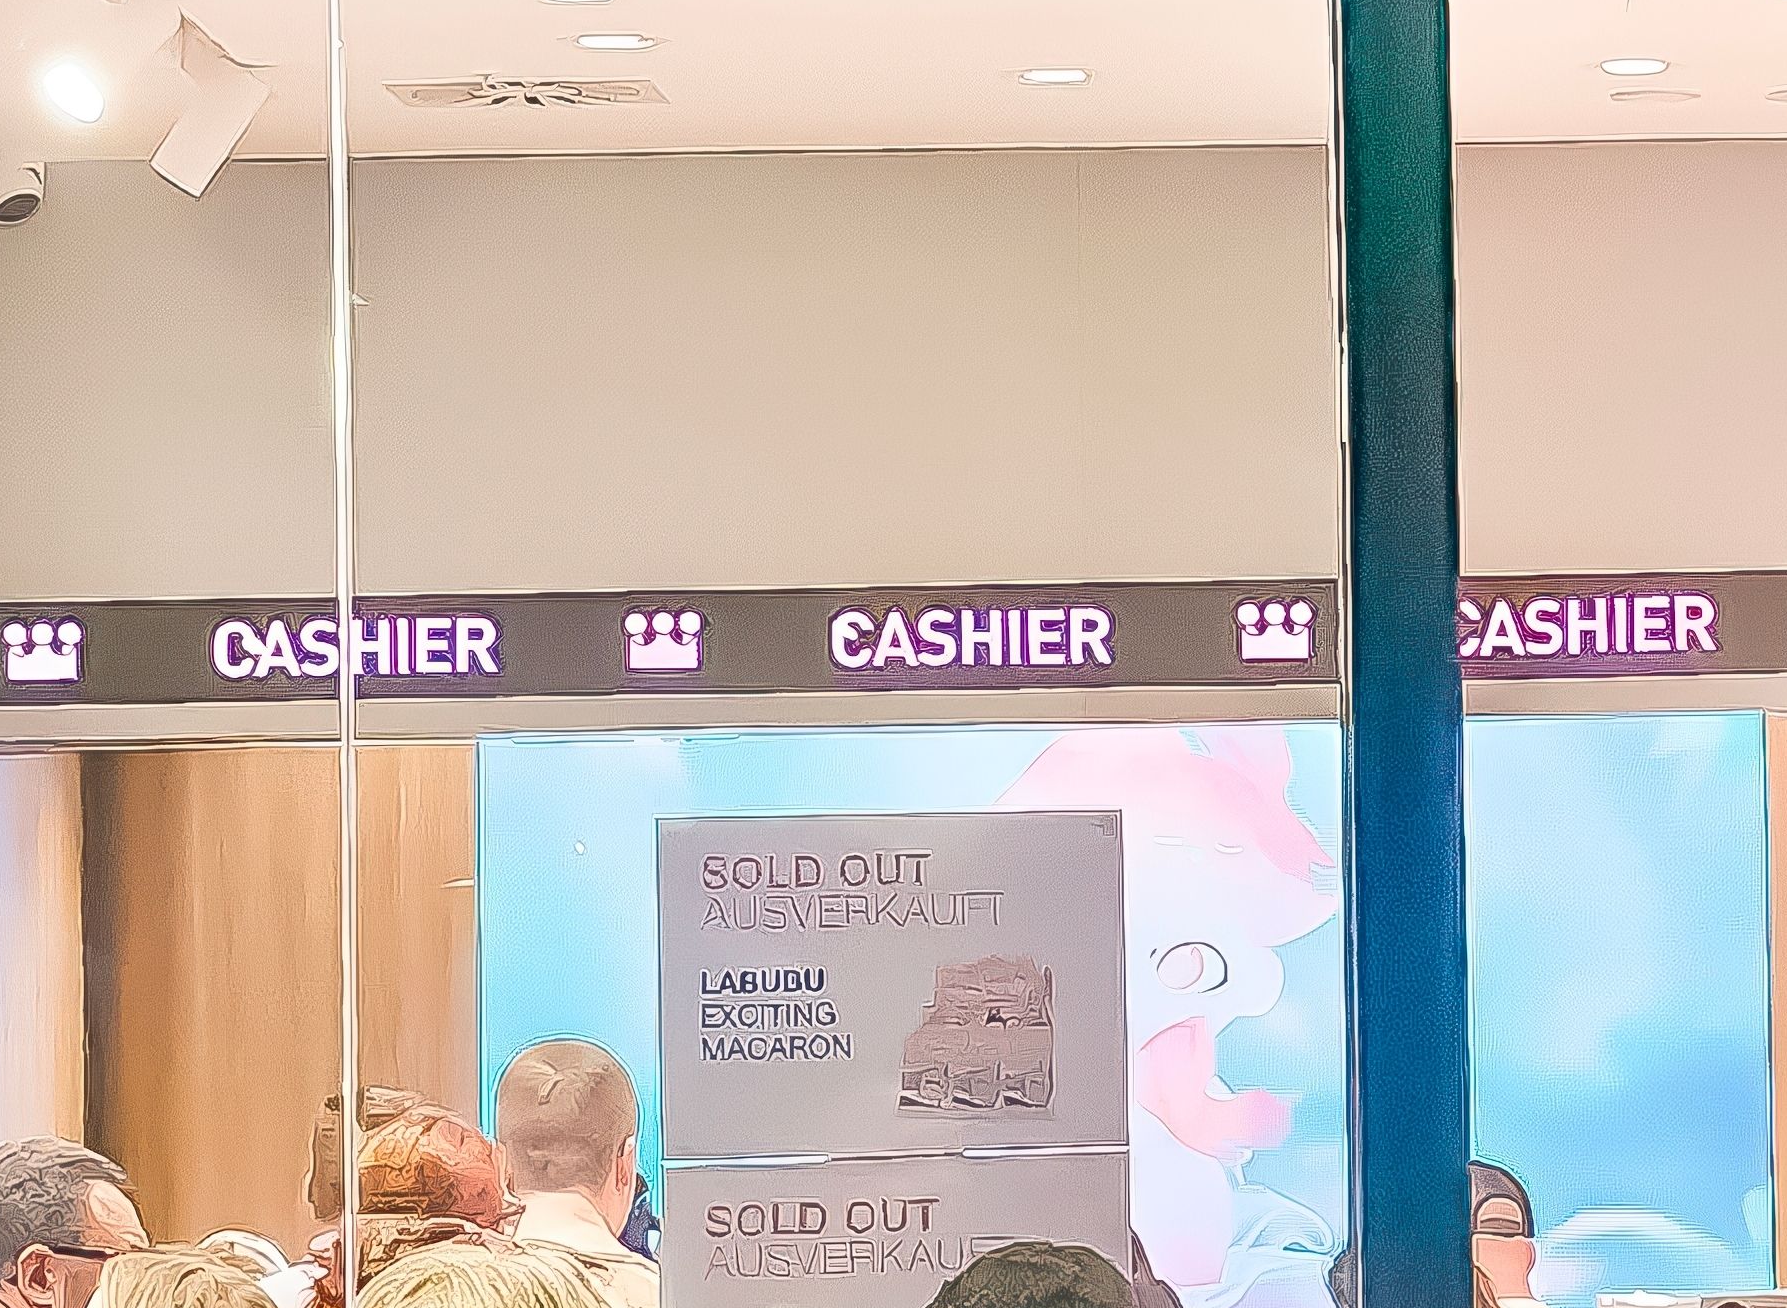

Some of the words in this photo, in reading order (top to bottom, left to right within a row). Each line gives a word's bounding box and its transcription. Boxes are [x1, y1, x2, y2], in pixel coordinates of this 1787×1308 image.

[214, 614, 501, 678] CASHIER
[830, 607, 1112, 668] CASHIER
[703, 852, 822, 890] SOLD
[840, 850, 933, 887] OUT
[700, 890, 1005, 931] AUSVERKAUFT
[701, 1033, 853, 1061] MACARON
[705, 1201, 827, 1237] SOLD
[845, 1197, 942, 1234] OUT
[704, 1235, 1017, 1281] AUSVERKAU
